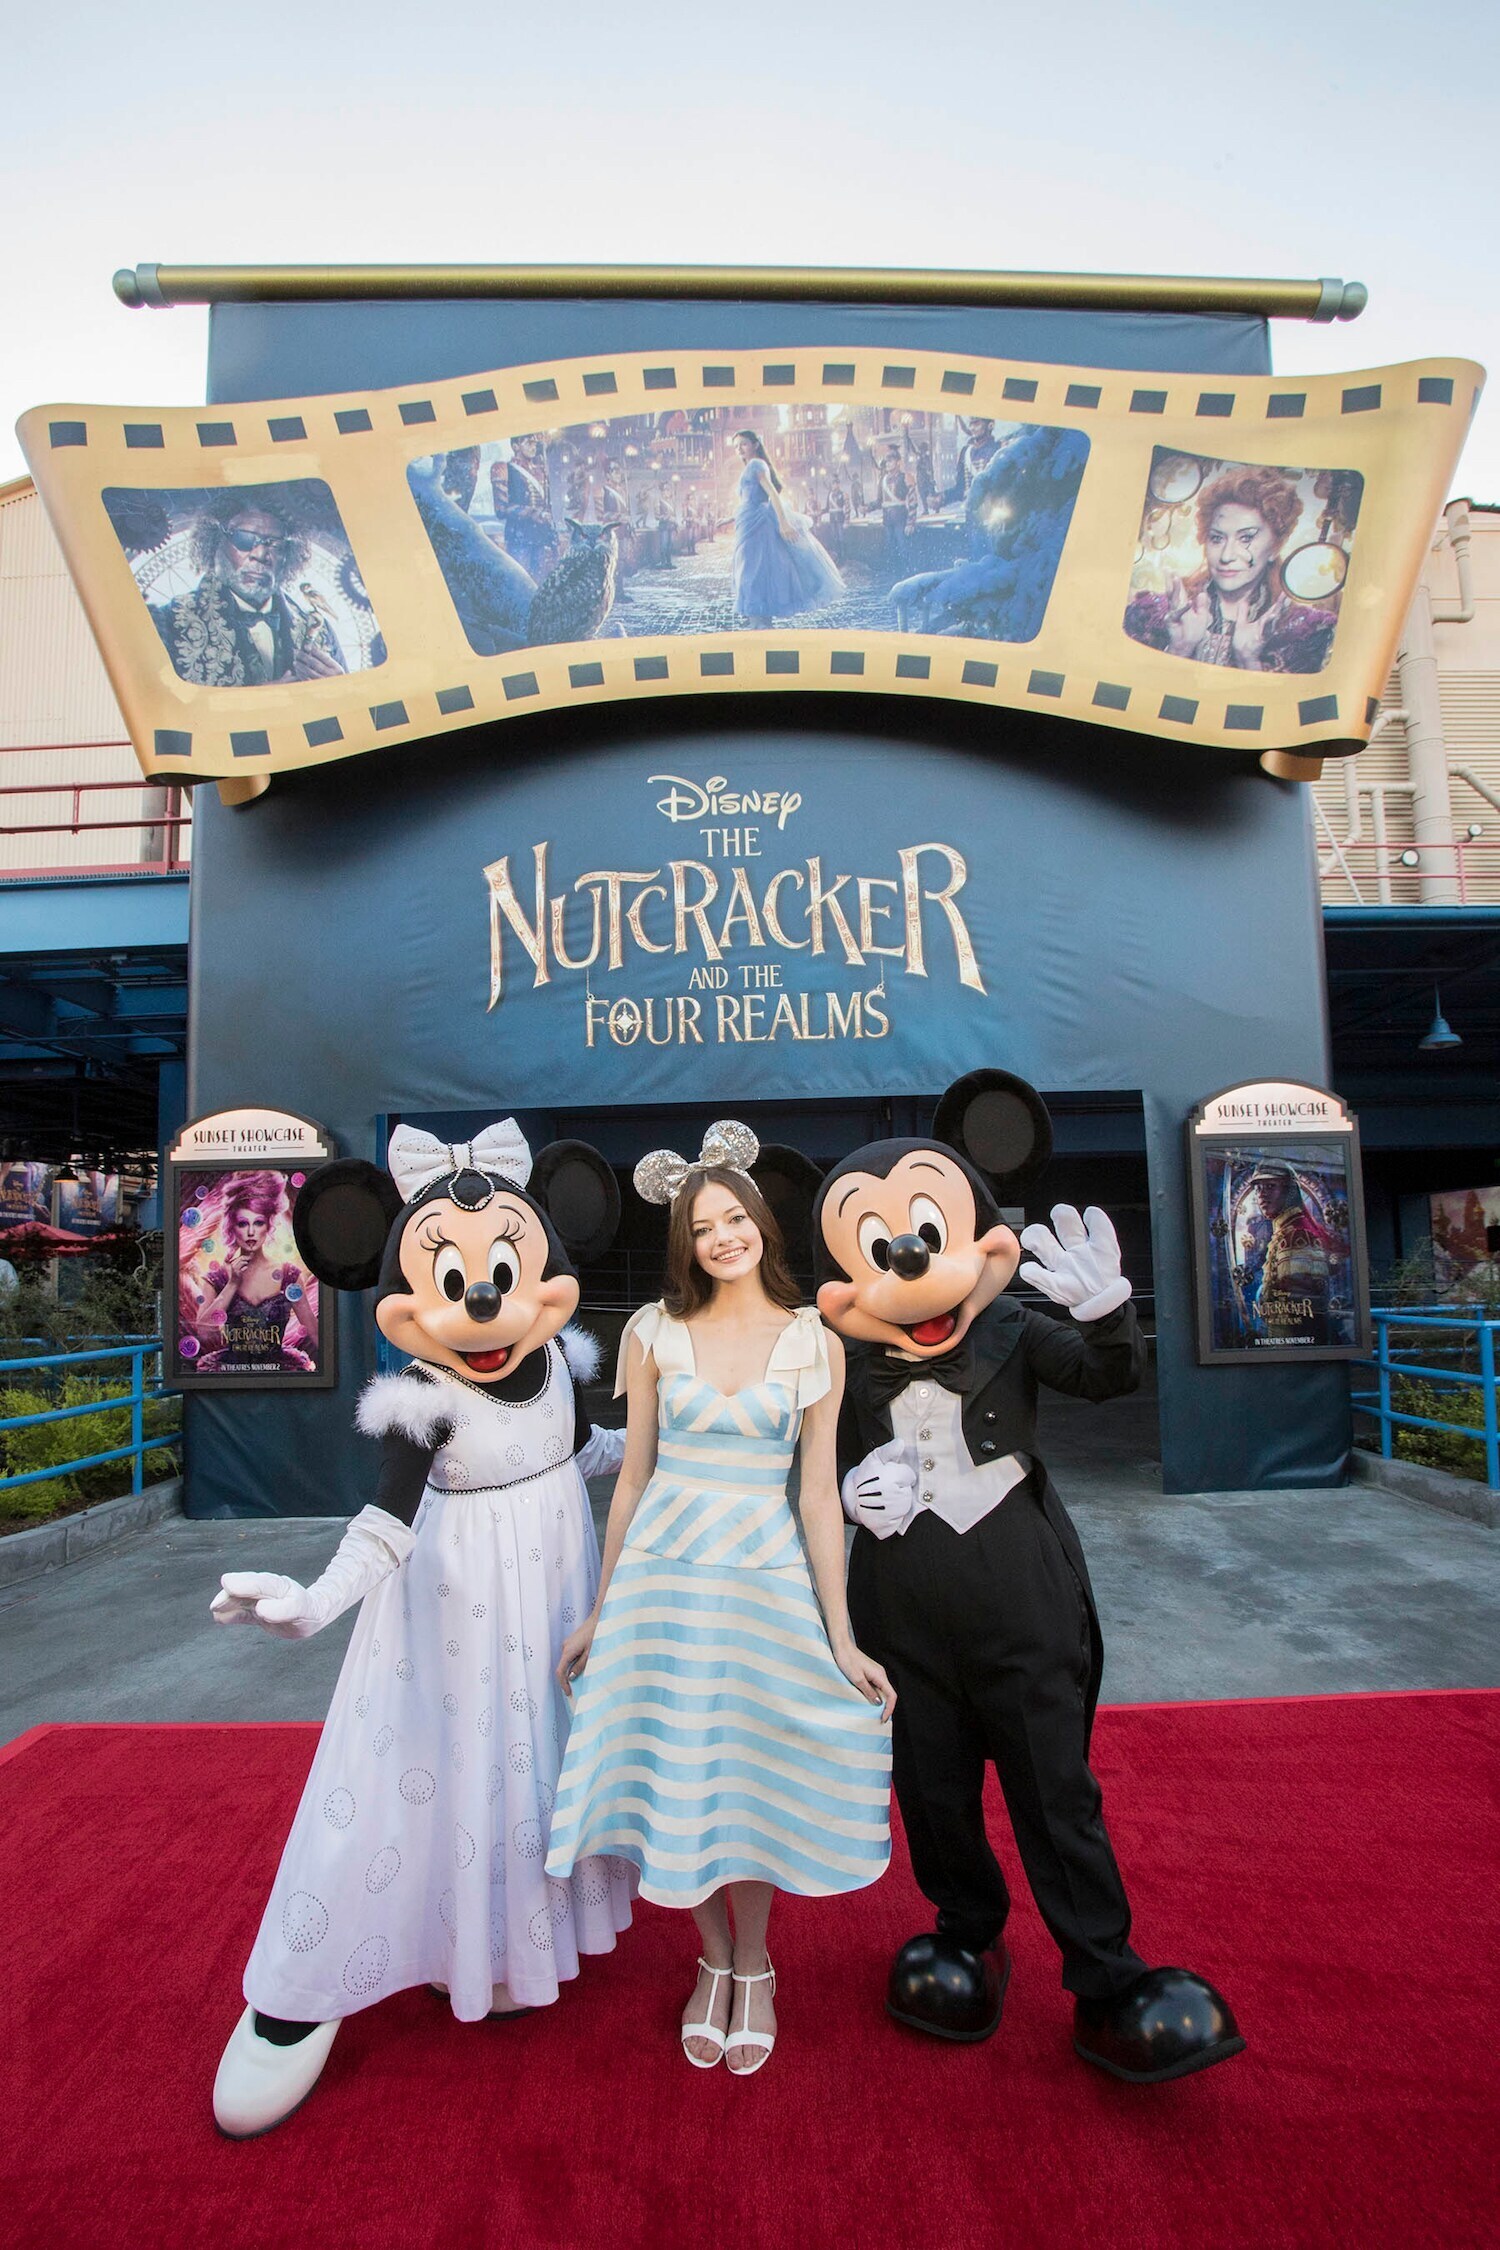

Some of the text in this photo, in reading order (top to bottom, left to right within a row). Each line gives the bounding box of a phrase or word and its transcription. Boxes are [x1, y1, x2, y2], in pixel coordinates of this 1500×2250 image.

[699, 827, 762, 858] THE
[482, 840, 989, 1014] NUTCRACKER
[688, 964, 784, 991] AND THE
[584, 989, 892, 1048] FOUR REALMS
[1217, 1101, 1329, 1118] SUNSET SHOWCASE
[1257, 1119, 1292, 1127] THEATER
[194, 1127, 305, 1144] SUNSET SHOWCASE
